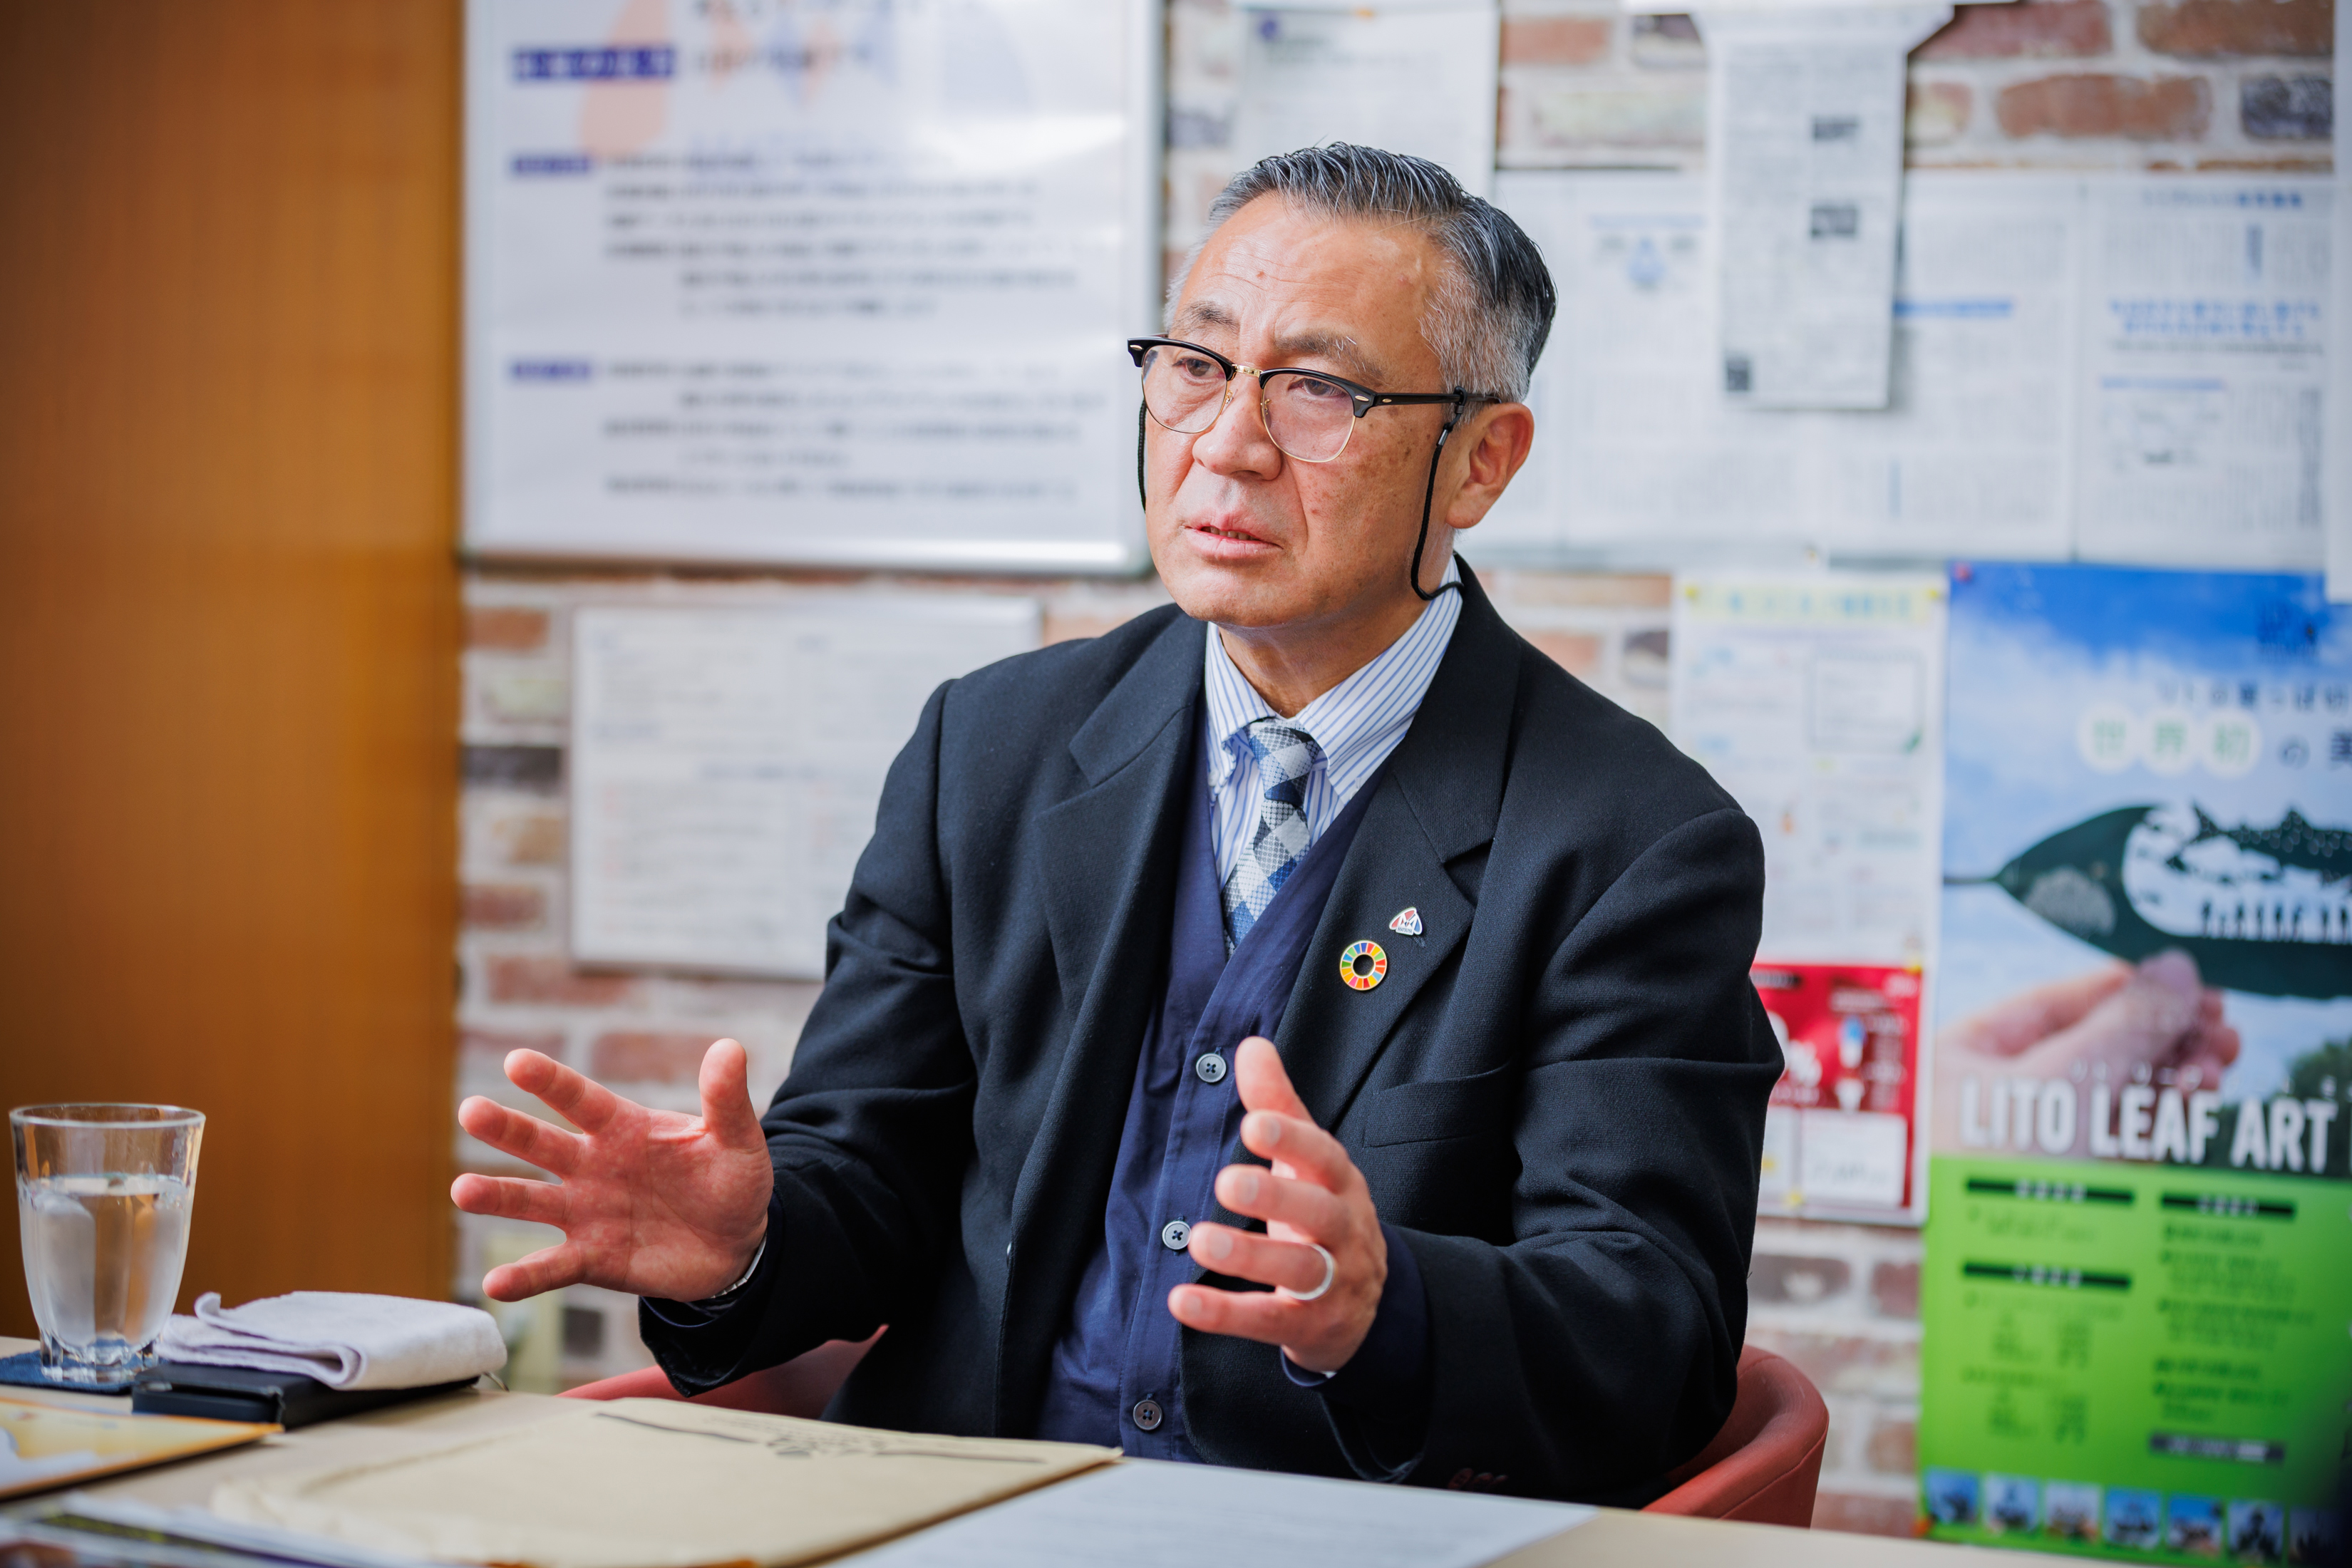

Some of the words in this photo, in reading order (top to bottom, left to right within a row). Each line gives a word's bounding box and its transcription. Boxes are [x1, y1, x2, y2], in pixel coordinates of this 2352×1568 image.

[1961, 1078, 2077, 1154] LITO
[2090, 1085, 2220, 1165] LEAF
[2232, 1096, 2338, 1172] ART
